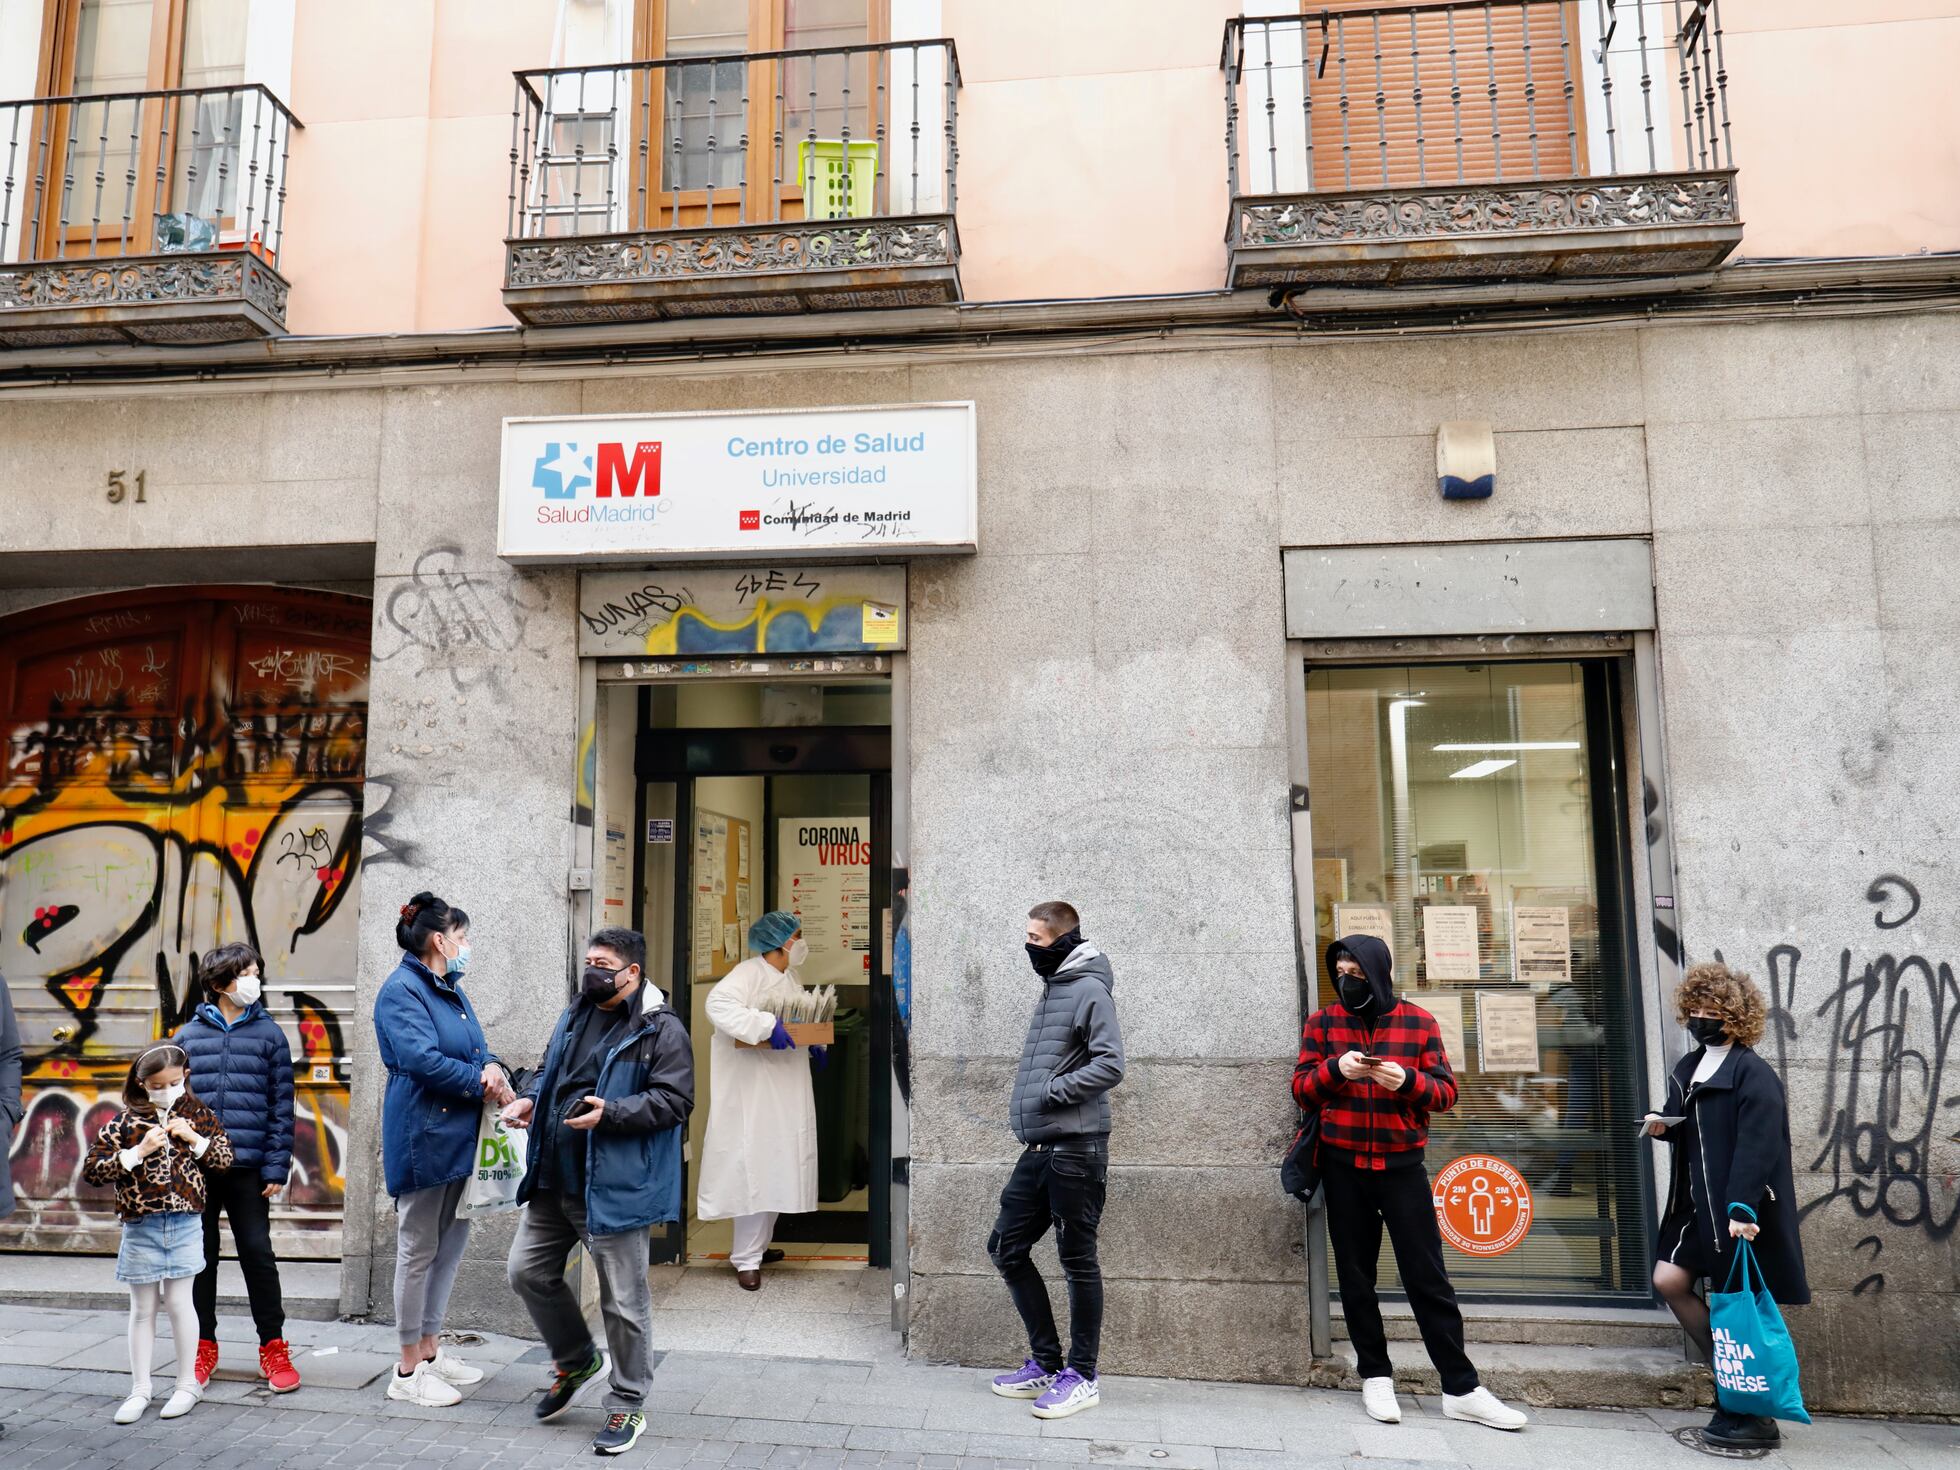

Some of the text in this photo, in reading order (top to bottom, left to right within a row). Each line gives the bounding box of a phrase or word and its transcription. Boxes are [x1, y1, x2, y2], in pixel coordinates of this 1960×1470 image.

[727, 431, 925, 458] Centro de Salud
[595, 441, 662, 498] M
[762, 465, 887, 488] Universidad
[107, 469, 147, 504] 51
[843, 512, 860, 523] de
[864, 509, 911, 523] Madrid
[799, 827, 860, 846] CORONA
[818, 842, 870, 865] VIRUS
[1440, 1159, 1521, 1188] PUNTO DE ESPERA
[1452, 1185, 1467, 1194] 2M
[1495, 1186, 1509, 1194] 2M
[1505, 1211, 1527, 1243] MANTENGA
[1472, 1241, 1506, 1251] DISTANCIA
[1714, 1343, 1754, 1359] ERIA
[1717, 1371, 1769, 1391] GHESE
